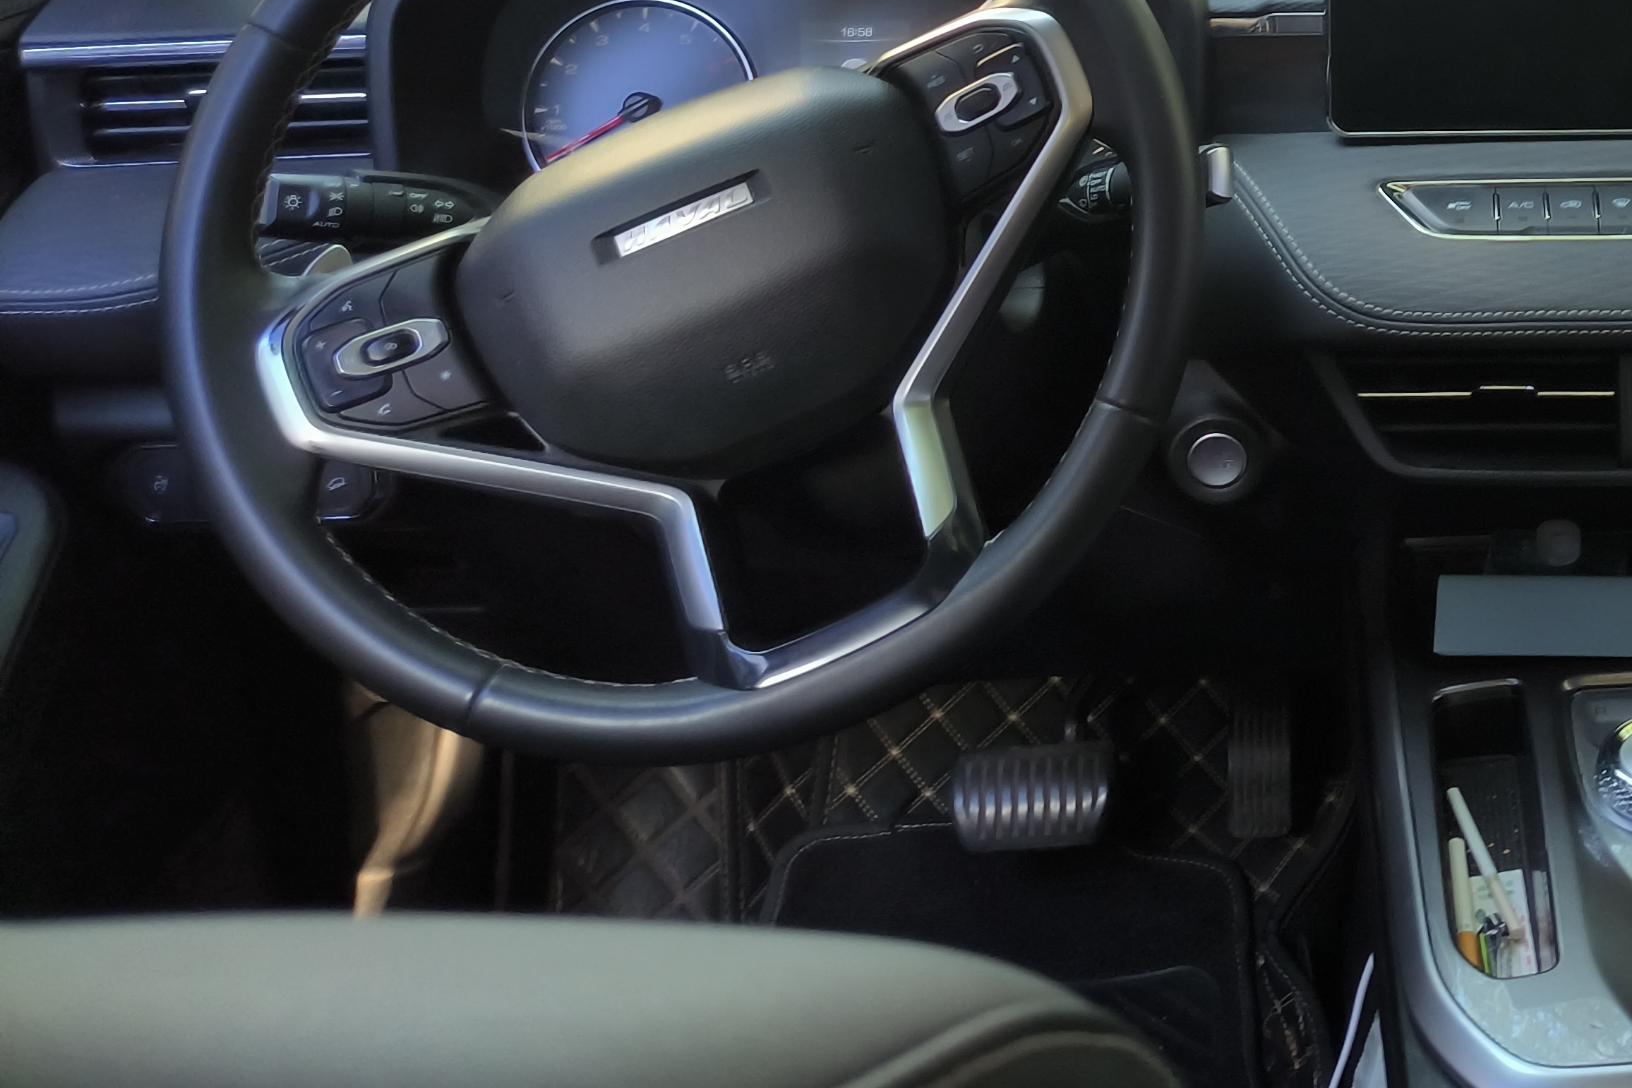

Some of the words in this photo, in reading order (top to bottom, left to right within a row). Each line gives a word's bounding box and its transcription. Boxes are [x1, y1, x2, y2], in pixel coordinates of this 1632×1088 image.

[595, 34, 609, 46] 3
[564, 64, 578, 76] 2
[1507, 200, 1535, 209] A/C
[312, 221, 341, 229] AUTO
